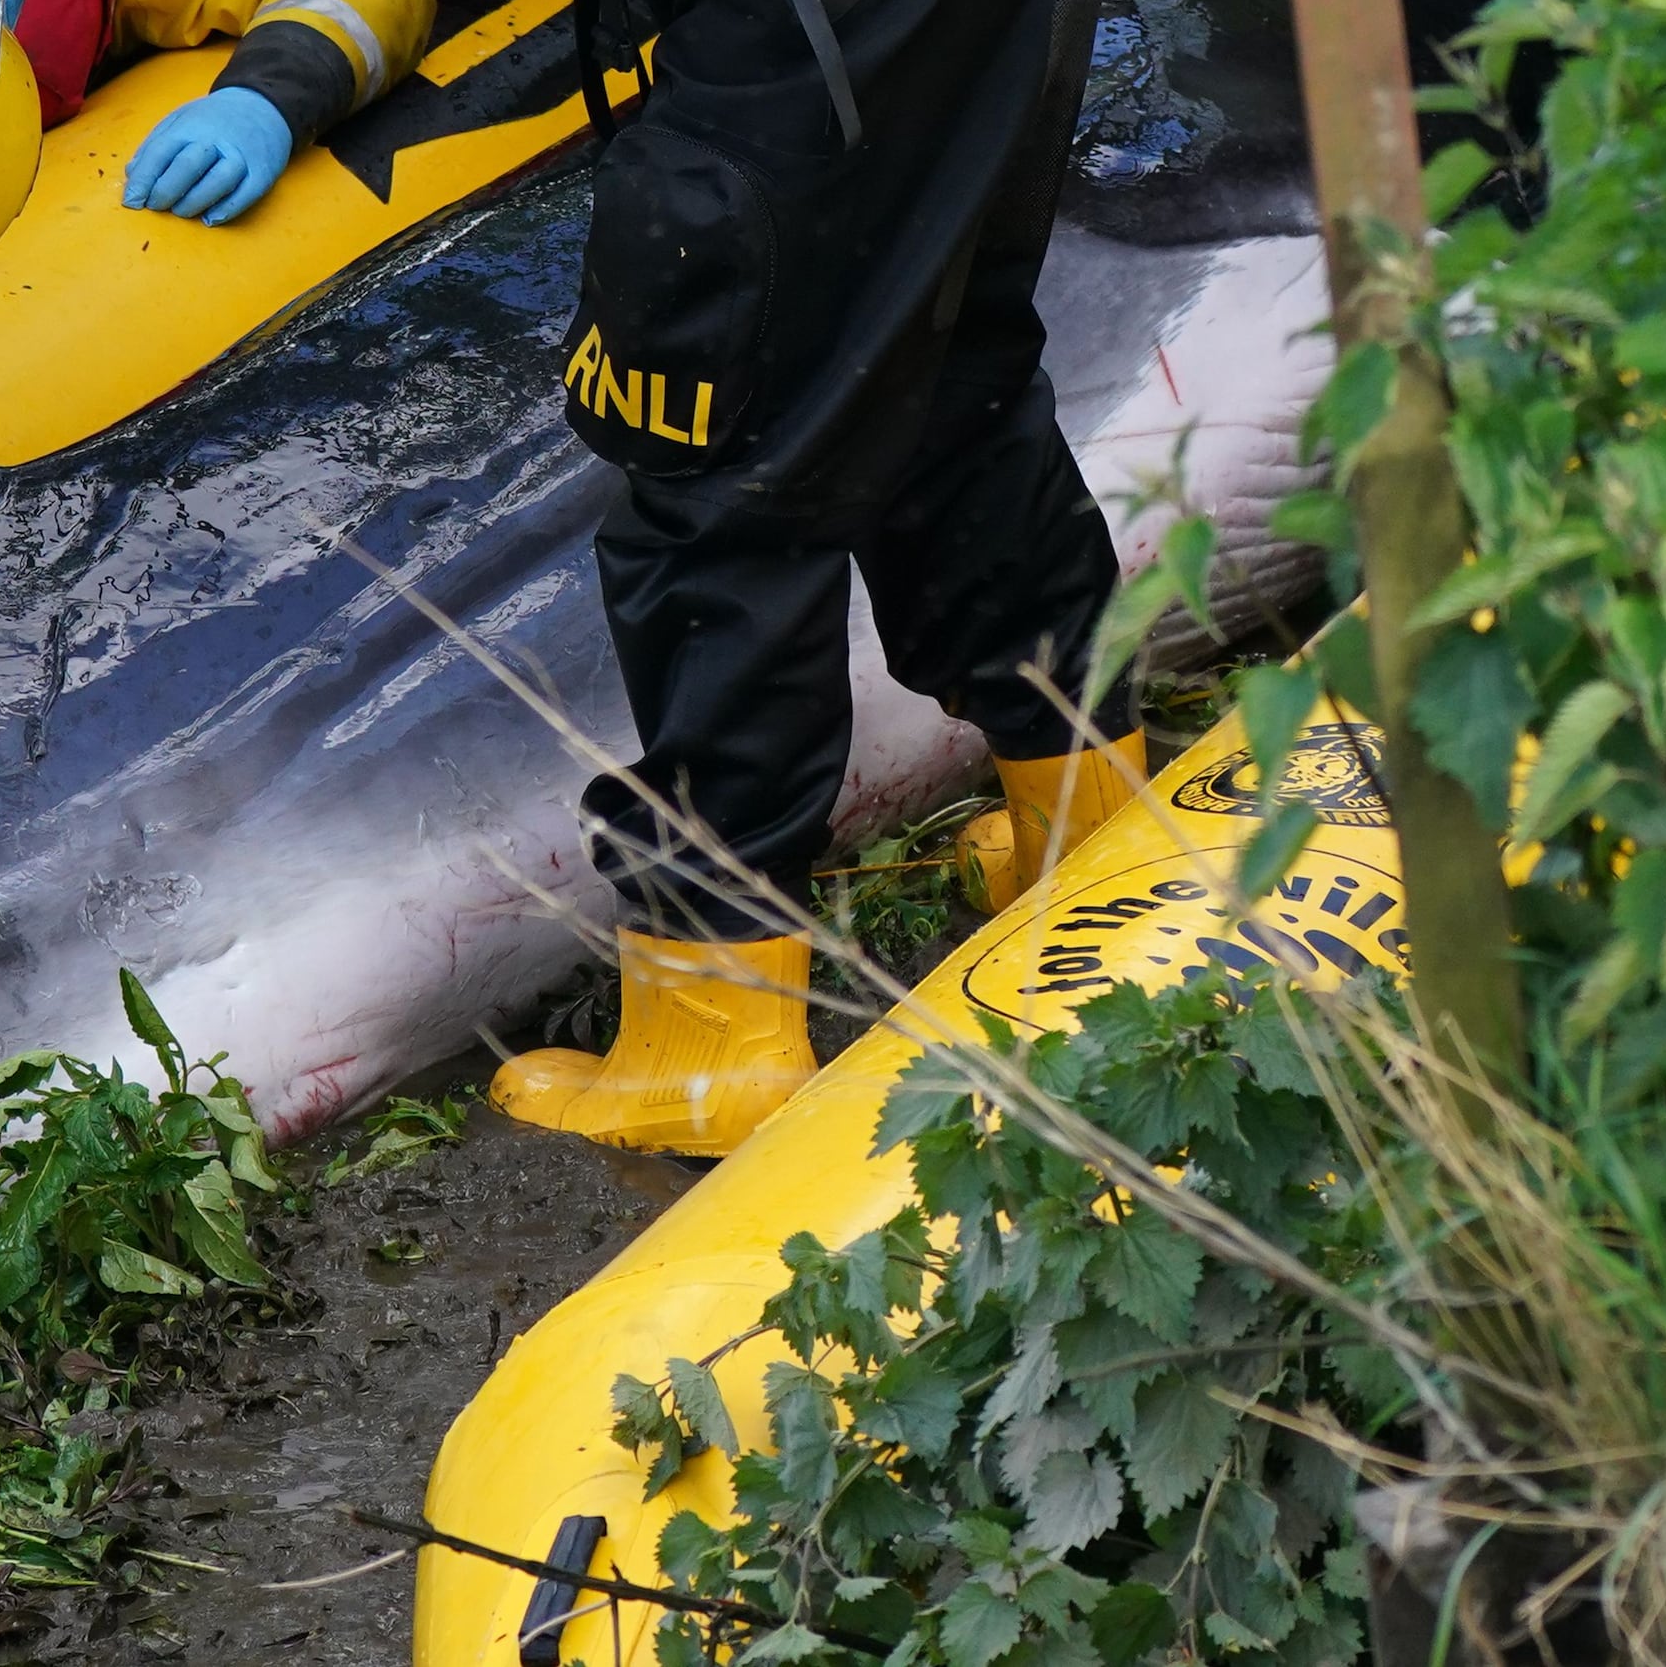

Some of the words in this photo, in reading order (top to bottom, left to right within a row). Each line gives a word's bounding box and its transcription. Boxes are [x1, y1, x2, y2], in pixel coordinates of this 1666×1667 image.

[564, 322, 714, 447] RNLI
[1052, 879, 1208, 932] the
[1017, 943, 1119, 996] for
